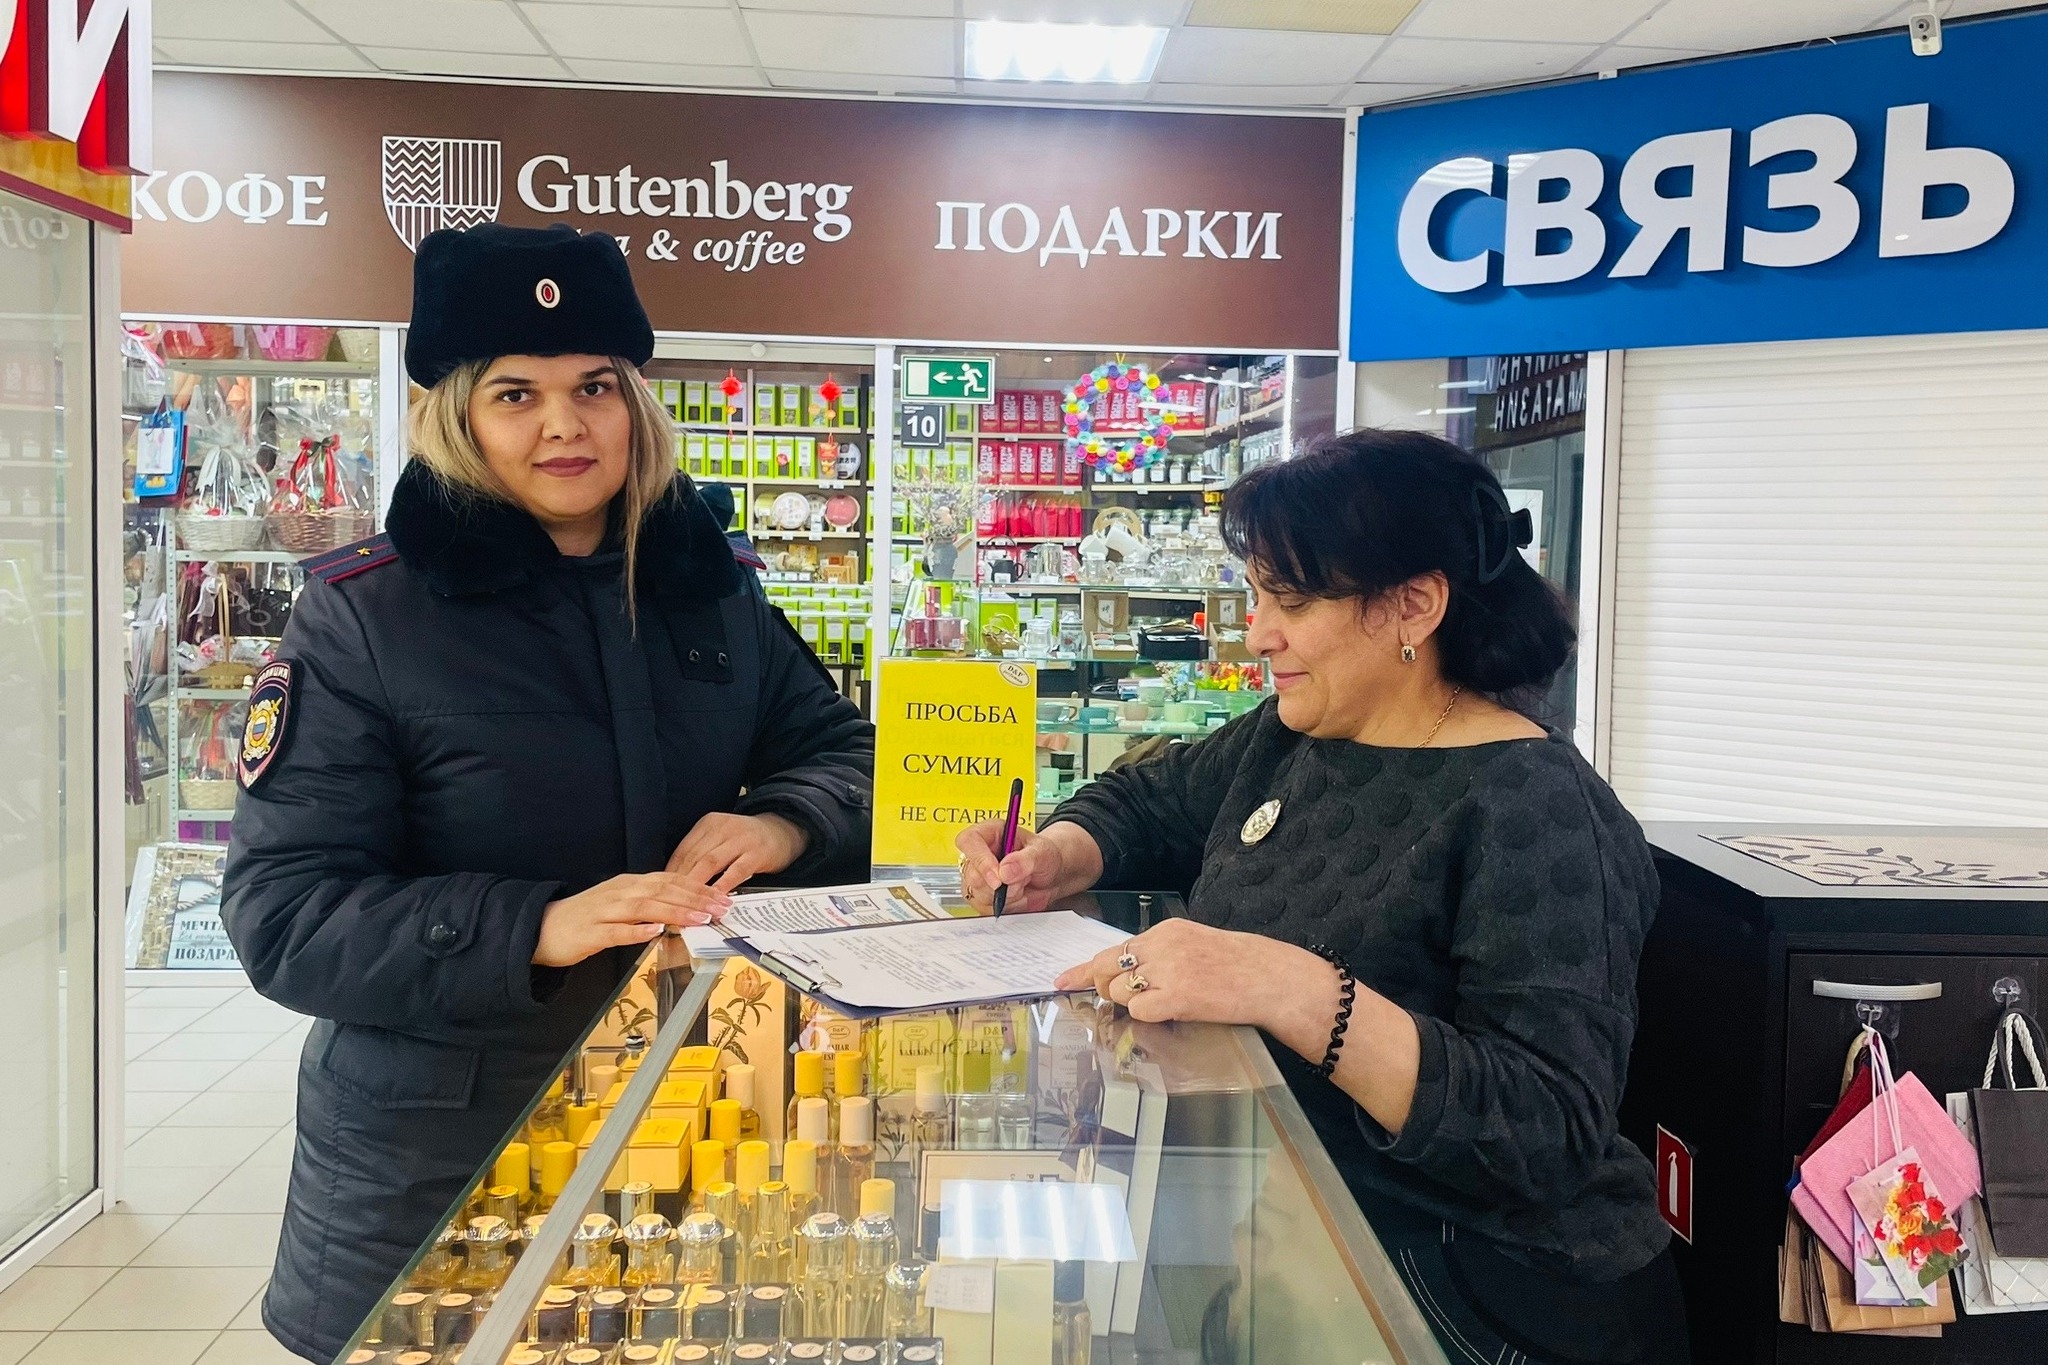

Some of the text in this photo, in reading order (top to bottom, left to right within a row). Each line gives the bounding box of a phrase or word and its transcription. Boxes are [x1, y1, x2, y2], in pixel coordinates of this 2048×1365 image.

[132, 170, 328, 226] КОФЕ
[517, 155, 853, 242] Gutenberg
[1397, 103, 2015, 293] СВЯЗЬ
[935, 201, 1283, 268] ПОДАРКИ
[645, 229, 680, 261] &
[693, 230, 806, 272] coffee
[907, 415, 936, 437] 10
[906, 702, 1018, 724] ПРОСЬБА
[903, 754, 1002, 777] СУМКИ
[900, 806, 927, 822] НЕ
[175, 948, 240, 960] ПОЗДРА
[983, 1026, 1008, 1036] D&P
